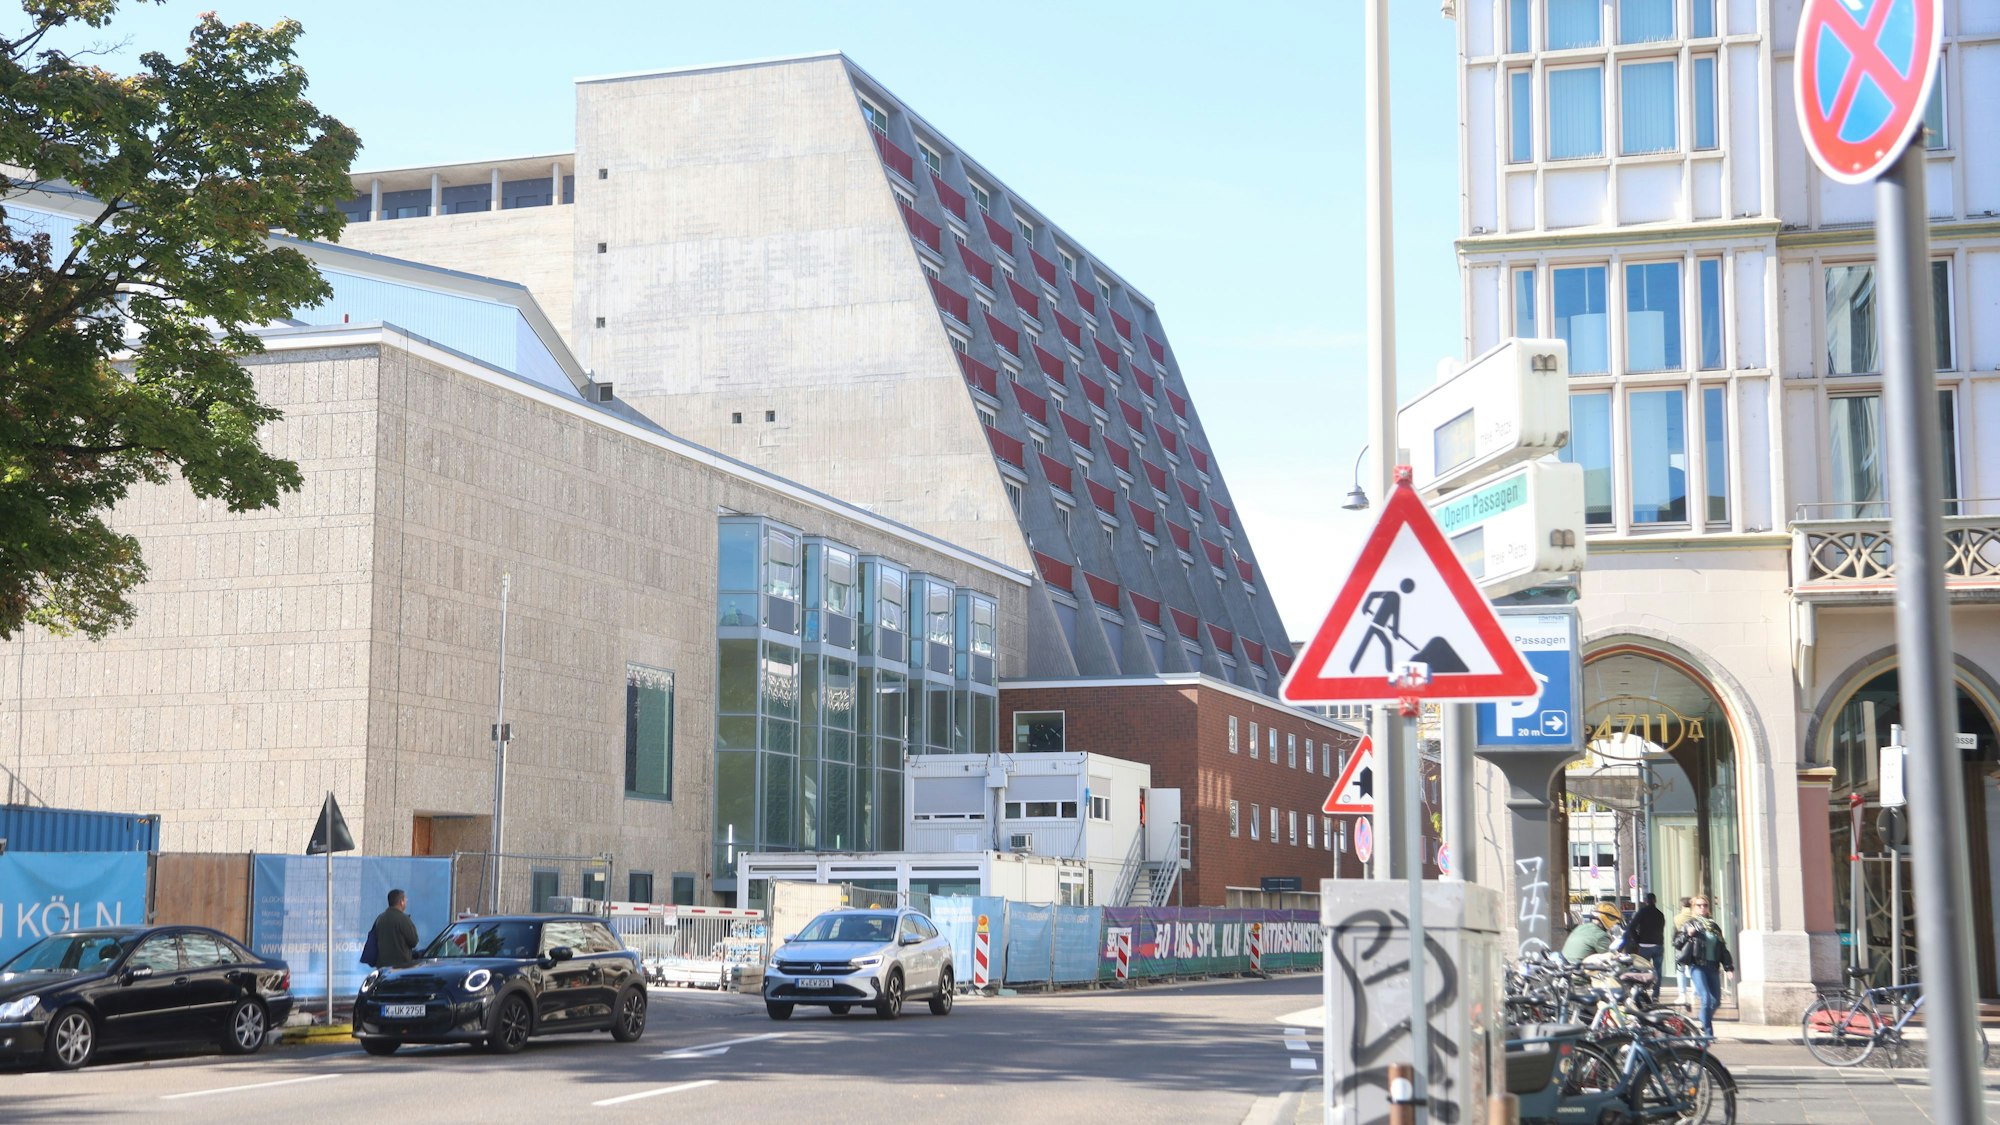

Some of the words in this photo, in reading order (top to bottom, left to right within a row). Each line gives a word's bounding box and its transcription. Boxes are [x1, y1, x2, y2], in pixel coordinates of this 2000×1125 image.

[1444, 506, 1471, 532] Opern
[1472, 484, 1519, 518] Passagen
[1514, 636, 1566, 647] Passagen
[1518, 728, 1530, 737] 20
[1531, 729, 1540, 737] m
[1590, 713, 1669, 744] 4711
[1954, 736, 1975, 746] asse
[1196, 922, 1217, 958] SPL
[1221, 923, 1240, 957] KLN
[261, 941, 365, 954] WWW.BUEHNE.KOELN
